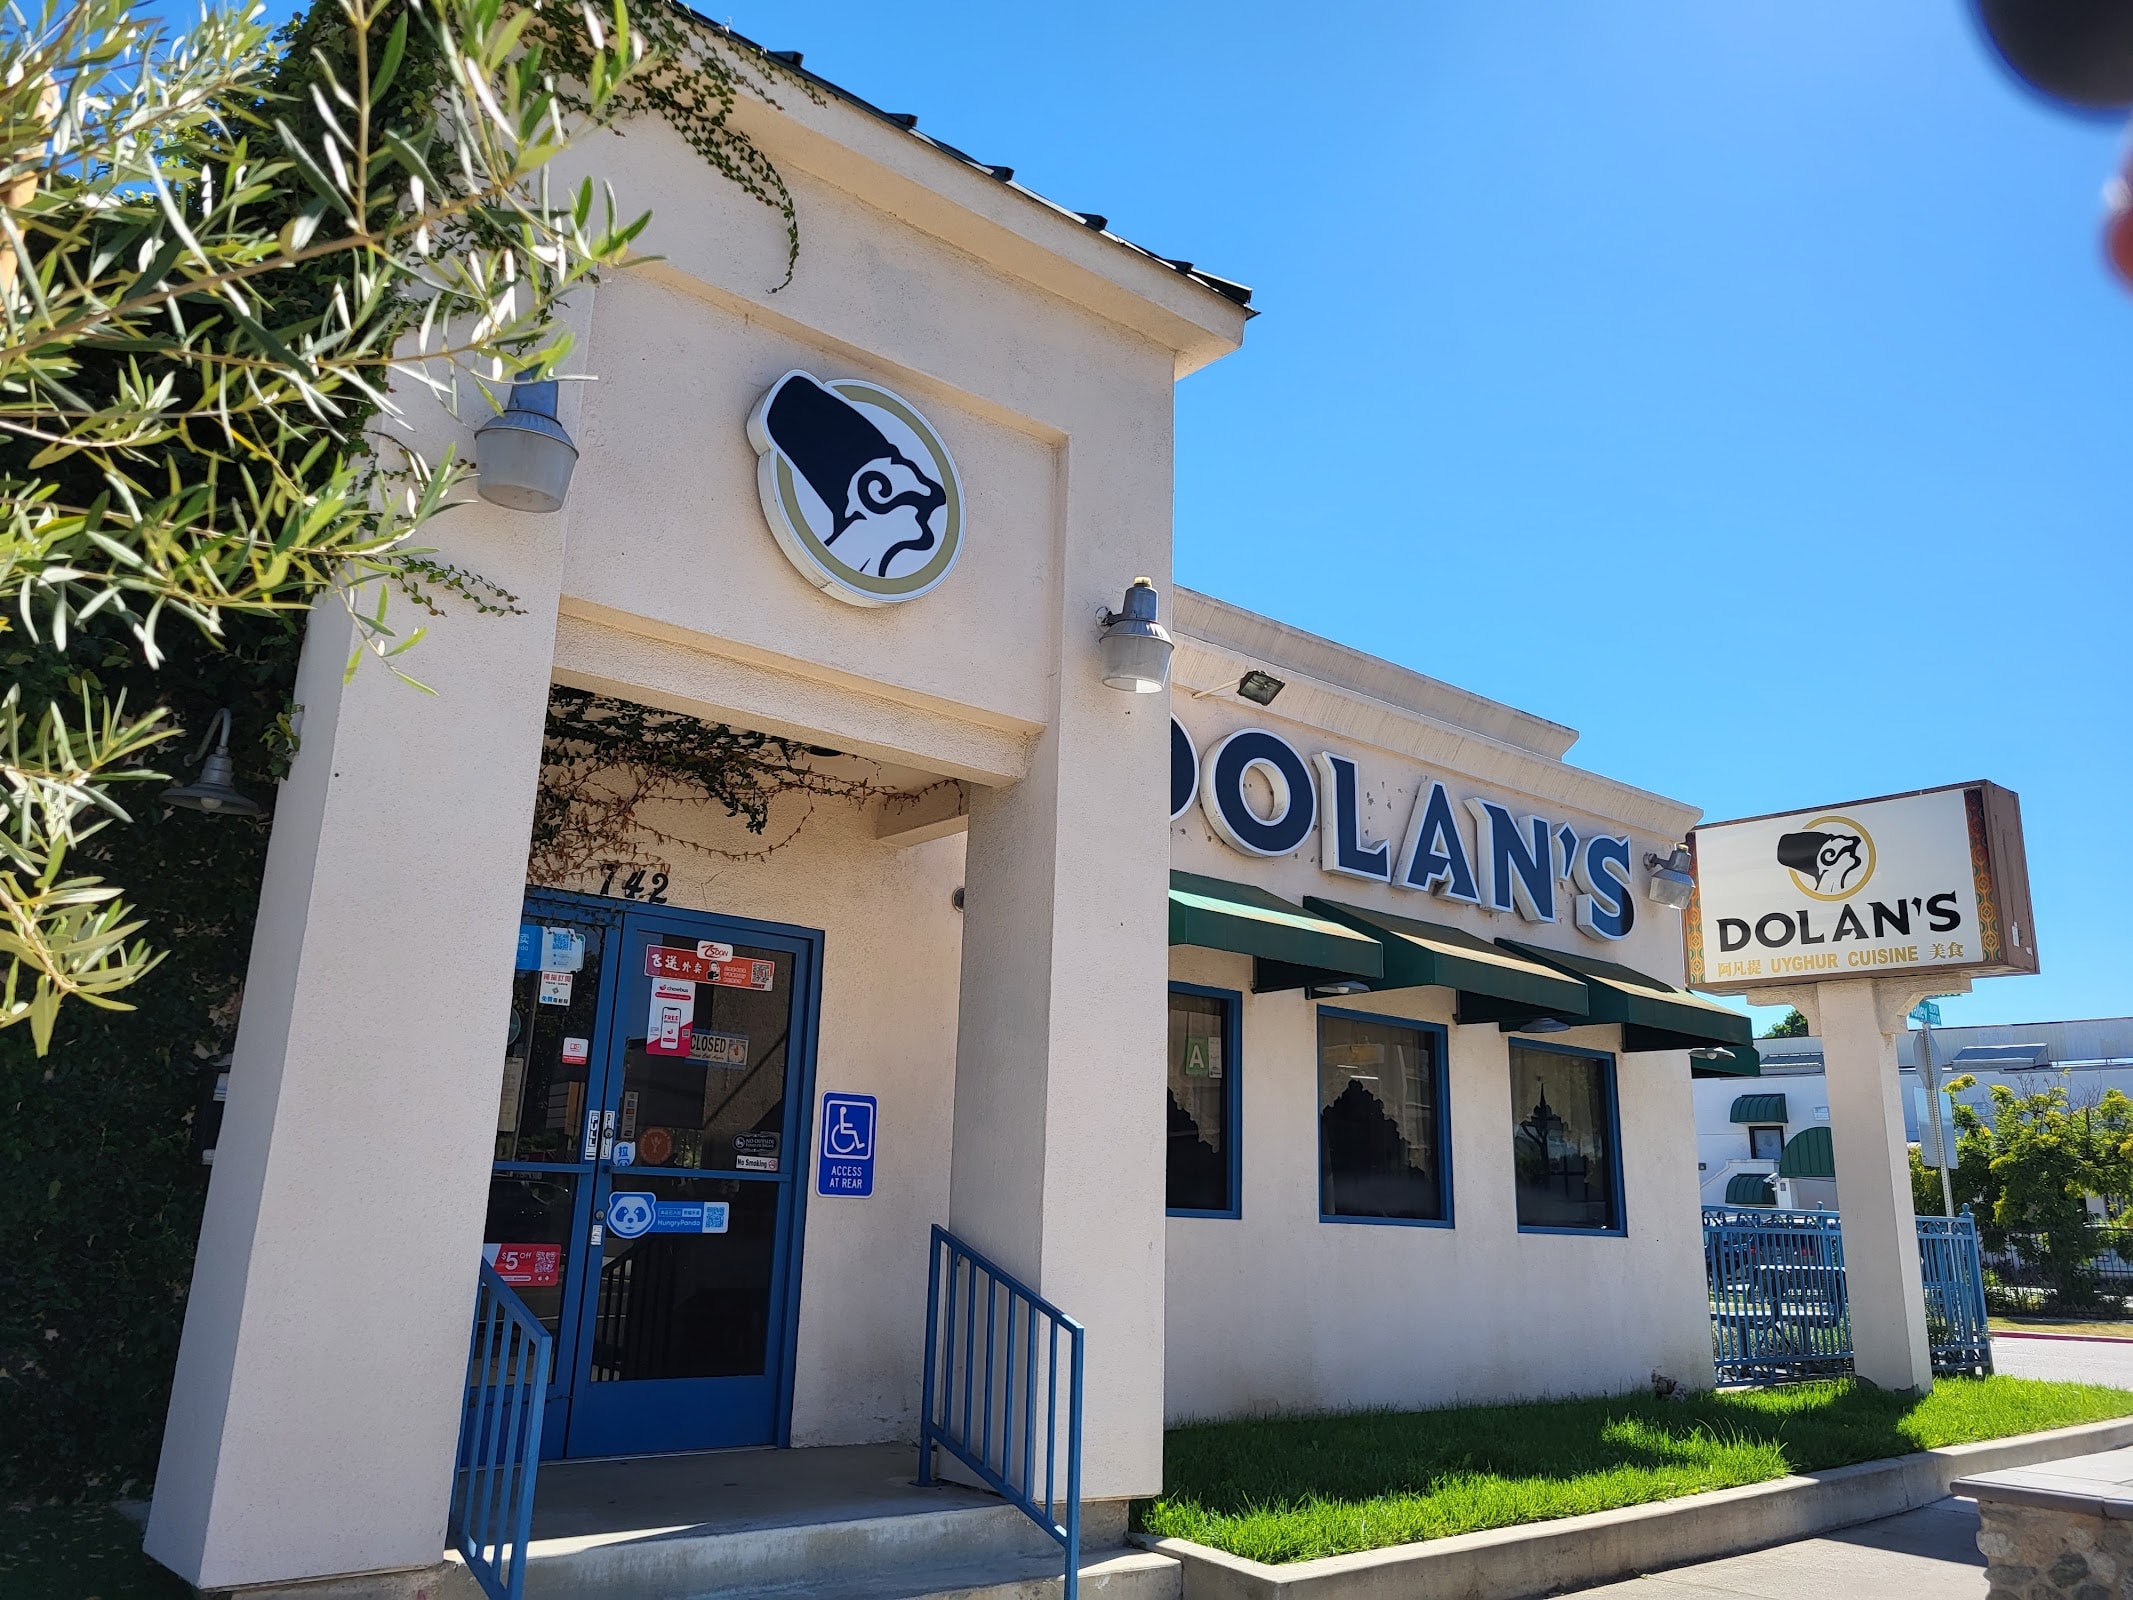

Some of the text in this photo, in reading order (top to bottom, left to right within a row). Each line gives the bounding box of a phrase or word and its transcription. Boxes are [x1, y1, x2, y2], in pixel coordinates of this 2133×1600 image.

[600, 863, 669, 904] 742
[1716, 890, 1961, 952] DOLAN'S
[651, 953, 703, 974] 飞送外卖
[1718, 941, 1964, 978] 阿凡提 UYGHUR CUISINE 美食
[690, 1034, 727, 1053] CLOSED
[1189, 1044, 1205, 1069] A
[588, 1115, 599, 1147] PULL
[745, 1159, 767, 1169] Smoking
[831, 1165, 863, 1177] ACCESS
[829, 1177, 863, 1189] AT REAR
[657, 1219, 701, 1228] HungryPanda
[502, 1251, 519, 1271] $5
